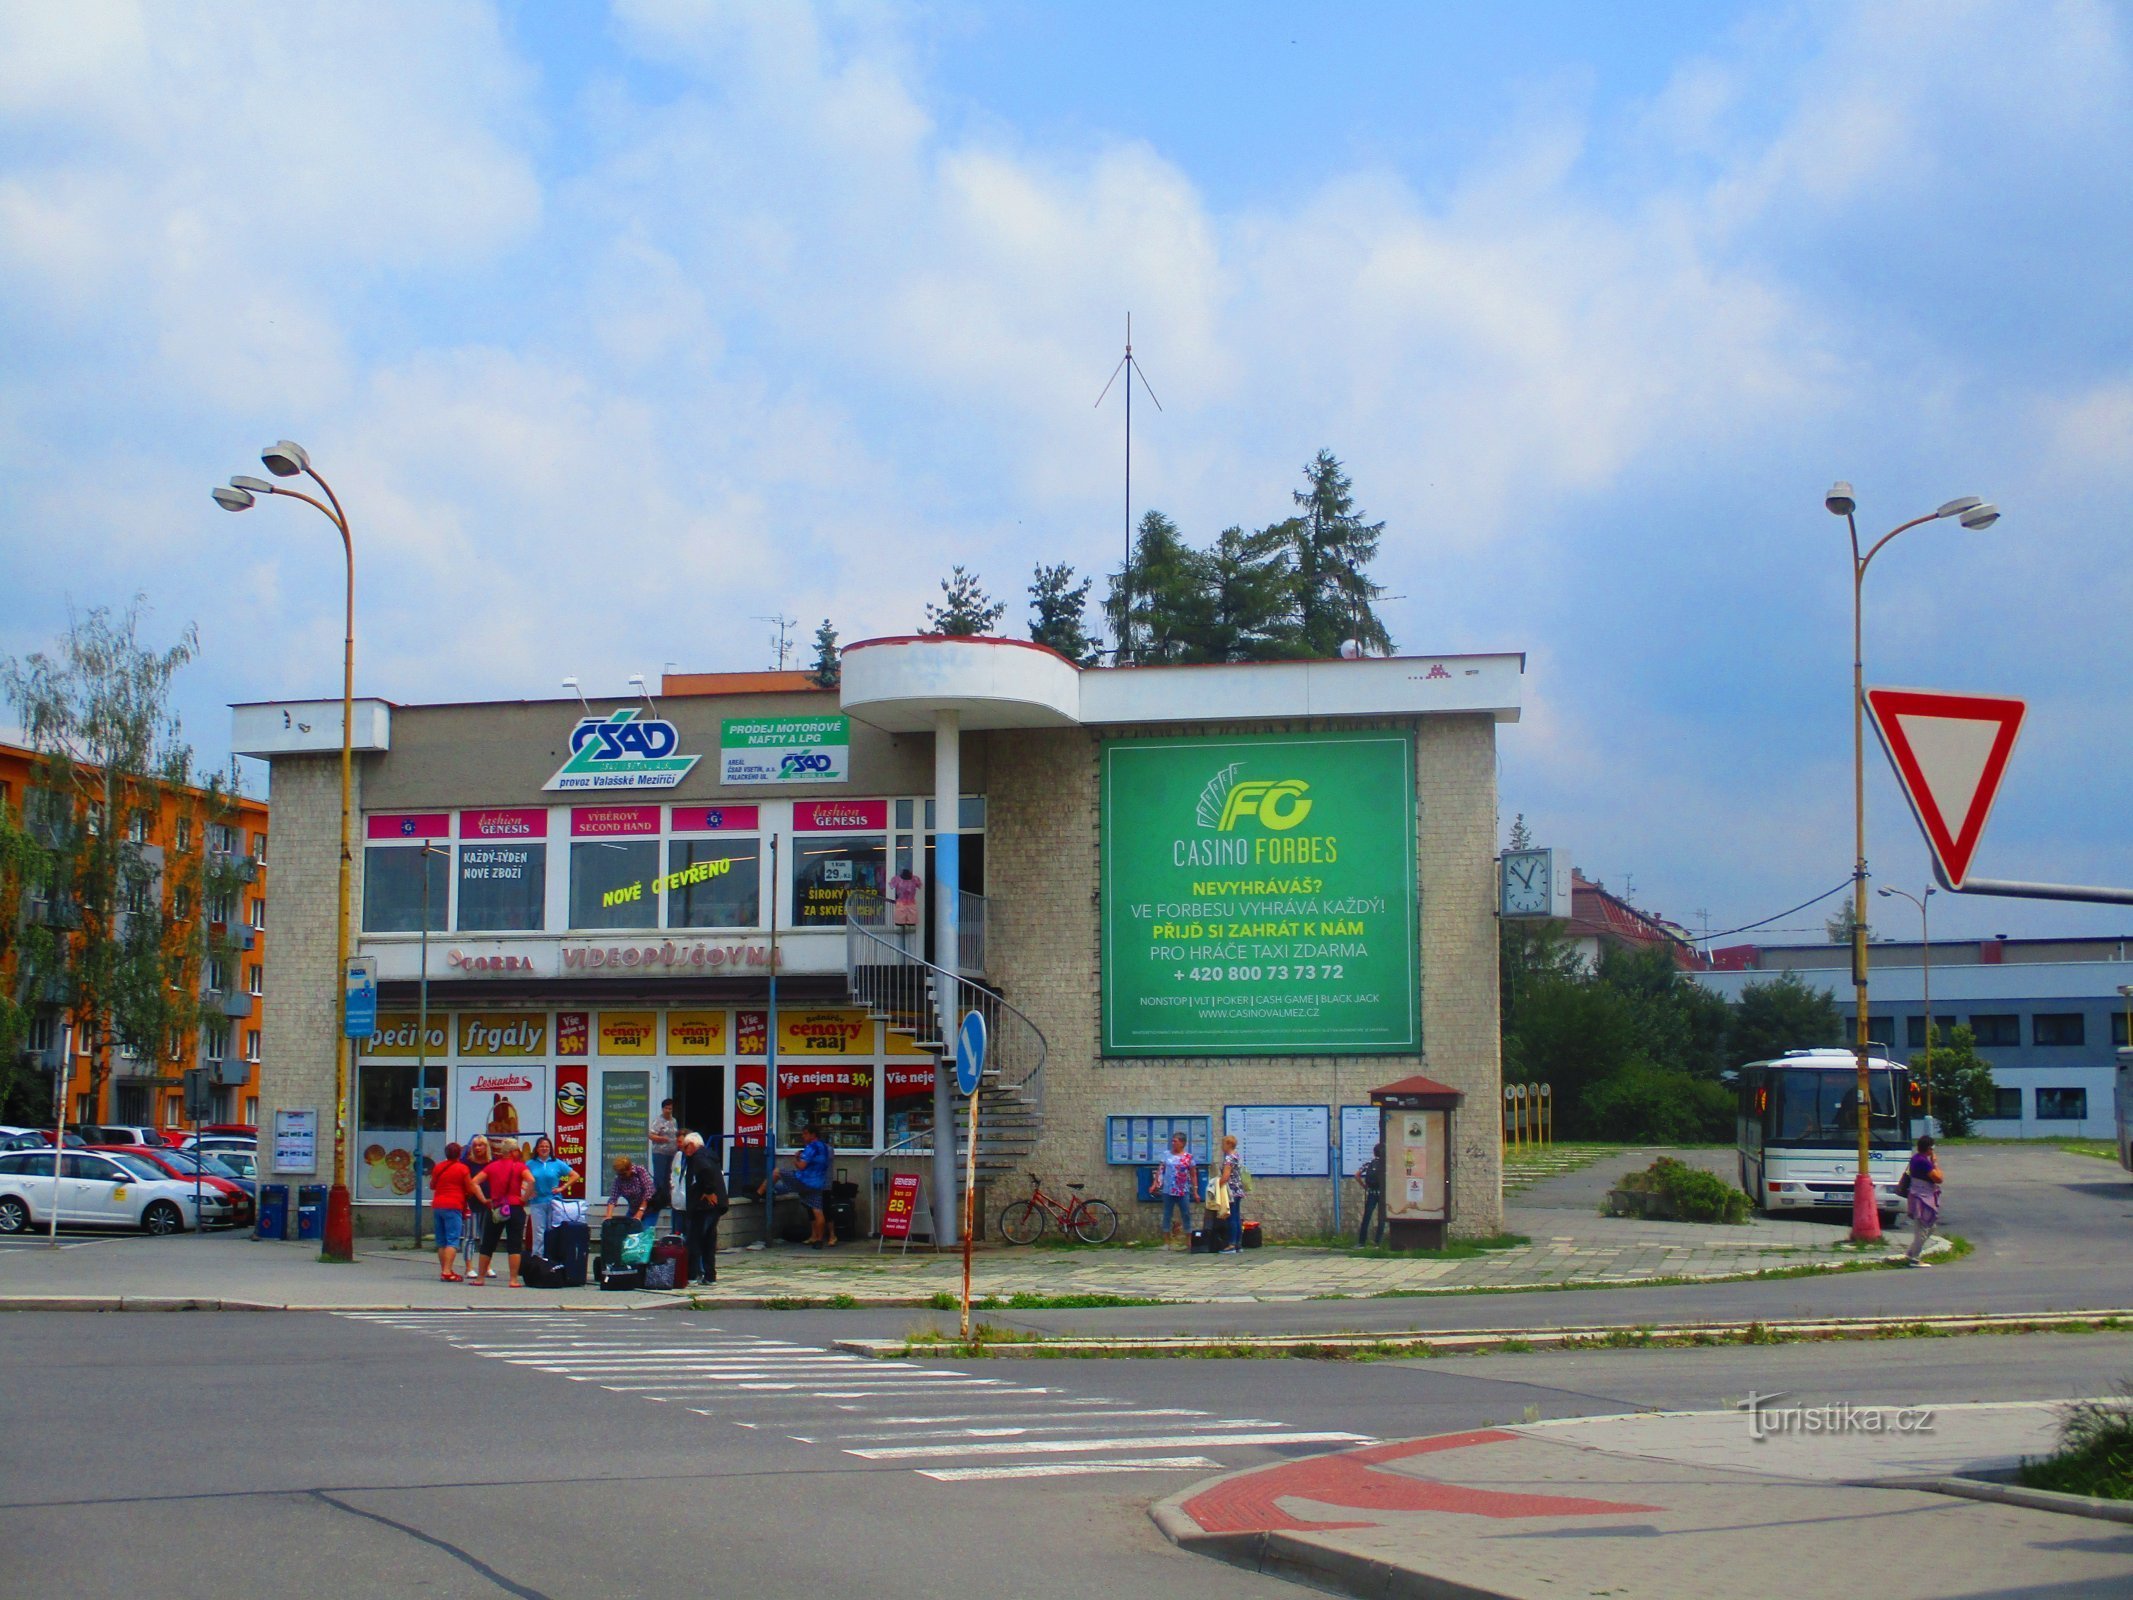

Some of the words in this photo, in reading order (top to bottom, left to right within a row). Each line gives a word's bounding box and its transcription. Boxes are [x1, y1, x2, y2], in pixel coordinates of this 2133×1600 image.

[729, 725, 775, 734] PRODEJ
[776, 720, 842, 733] MOTOROVÉ
[571, 719, 676, 760] ČSAD
[748, 735, 786, 744] NAFTY
[788, 735, 796, 743] A
[798, 734, 822, 743] LPG
[781, 753, 832, 773] ČSAD
[559, 778, 590, 788] provoz
[593, 775, 635, 786] Valašské
[638, 774, 677, 785] Meziříčí
[587, 810, 640, 822] VÝBĚROVÝ
[813, 804, 860, 821] fashion
[404, 823, 412, 831] G
[478, 813, 522, 829] fashion
[579, 823, 620, 832] SECOND
[623, 822, 652, 831] HAND
[815, 816, 868, 826] GENESIS
[481, 824, 530, 834] GENESIS
[463, 850, 495, 863] KAŽDÝ
[497, 850, 528, 863] TÝDEN
[1173, 838, 1249, 867] CASINO
[1255, 836, 1338, 865] FORBES
[464, 866, 490, 879] NOVÉ
[491, 865, 522, 879] ZBOŽÍ
[602, 880, 642, 907] NOVĚ
[651, 858, 730, 895] OTEVŘENO
[1192, 876, 1323, 896] NEVYHRÁVÁŠ?
[808, 886, 844, 900] ŠIROKÝ
[804, 905, 817, 916] ZA
[1131, 904, 1152, 918] VE
[1157, 901, 1235, 918] FORBESU
[1240, 898, 1319, 917] VYHRÁVÁ
[1323, 896, 1386, 916] KAŽDÝ!
[1152, 921, 1203, 940] PŘIJĎ
[1208, 924, 1223, 938] SI
[1228, 920, 1300, 938] ZAHRÁT
[1304, 923, 1316, 937] K
[1320, 919, 1364, 936] NÁM
[1150, 946, 1185, 961] PRO
[1190, 942, 1248, 960] HRÁČE
[1251, 943, 1289, 959] TAXI
[1293, 943, 1369, 959] ZDARMA
[1189, 966, 1223, 981] 420
[1228, 966, 1262, 981] 800
[1267, 966, 1289, 980] 73
[1294, 965, 1316, 980] 73
[1321, 965, 1344, 979] 72
[1140, 996, 1187, 1006] NONSTOP
[1193, 996, 1211, 1005] VLT
[1217, 995, 1249, 1005] POKER
[1255, 994, 1282, 1005] CASH
[1284, 994, 1314, 1004] GAME
[1320, 994, 1351, 1004] BLACK
[1353, 993, 1380, 1003] JACK
[562, 1015, 580, 1026] Vše
[741, 1014, 758, 1026] Vše
[1198, 1008, 1320, 1019] WWW.CASINOVALMEZ.CZ
[462, 1020, 543, 1053] frgály
[602, 1024, 651, 1038] cenový
[671, 1024, 720, 1038] cenový
[789, 1019, 863, 1040] cenový
[613, 1036, 641, 1047] raaj
[682, 1036, 710, 1047] raaj
[805, 1036, 846, 1052] raaj
[779, 1071, 800, 1084] Vše
[802, 1072, 835, 1086] nejen
[836, 1073, 850, 1083] za
[886, 1071, 907, 1084] Vše
[909, 1070, 935, 1086] neje
[560, 1134, 580, 1144] Vám
[558, 1144, 584, 1155] tváře
